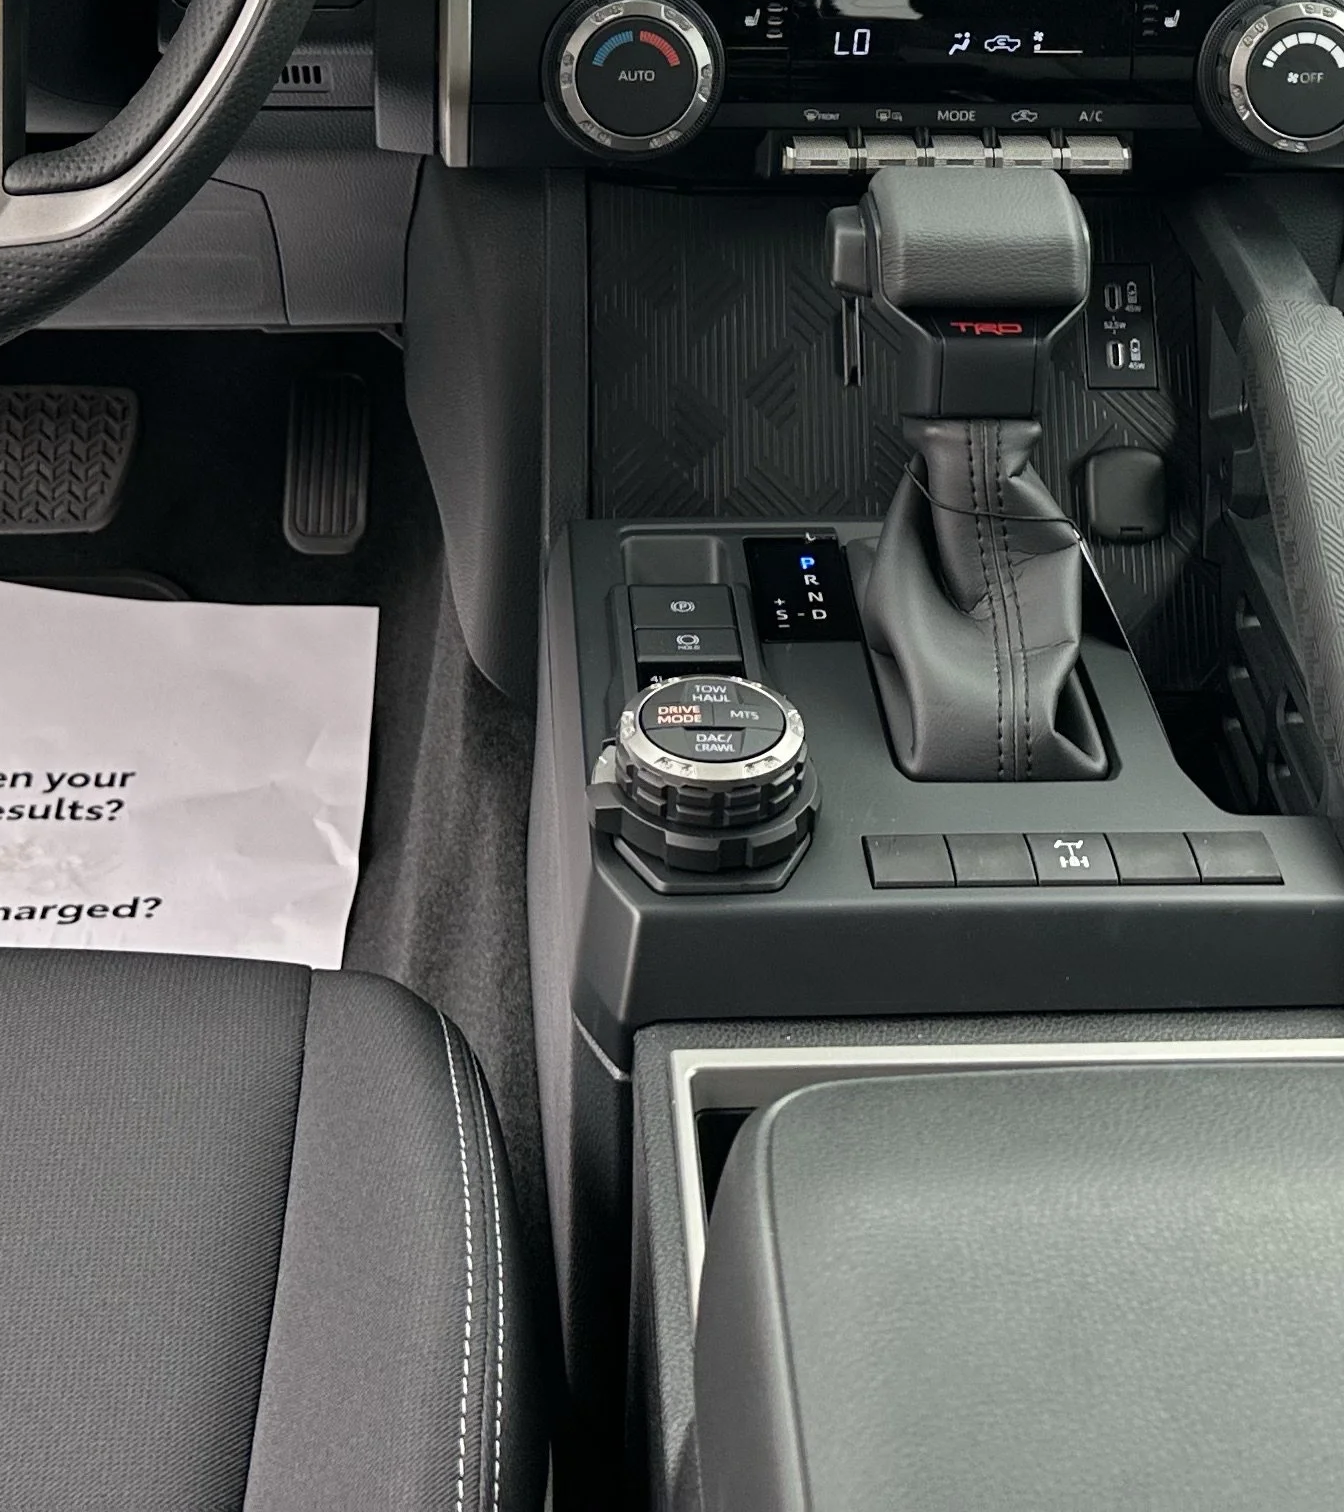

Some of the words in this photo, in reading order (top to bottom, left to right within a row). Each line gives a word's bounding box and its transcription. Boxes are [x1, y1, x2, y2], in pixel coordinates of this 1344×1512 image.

[832, 28, 872, 57] LO
[617, 68, 656, 83] AUTO
[1299, 71, 1325, 86] OFF
[936, 109, 977, 123] MODE
[1078, 109, 1105, 124] A/C
[949, 320, 1023, 337] TRD
[799, 556, 816, 570] P
[803, 573, 820, 586] R
[807, 591, 825, 603] N
[775, 609, 789, 621] S
[811, 609, 828, 621] D
[694, 684, 728, 694] TOW
[691, 693, 732, 704] HAUL
[657, 704, 701, 716] DRIVE
[729, 710, 761, 721] MTS
[657, 714, 703, 725] MODE
[696, 732, 734, 744] DAC/
[694, 743, 736, 753] CRAWL
[41, 767, 138, 794] your
